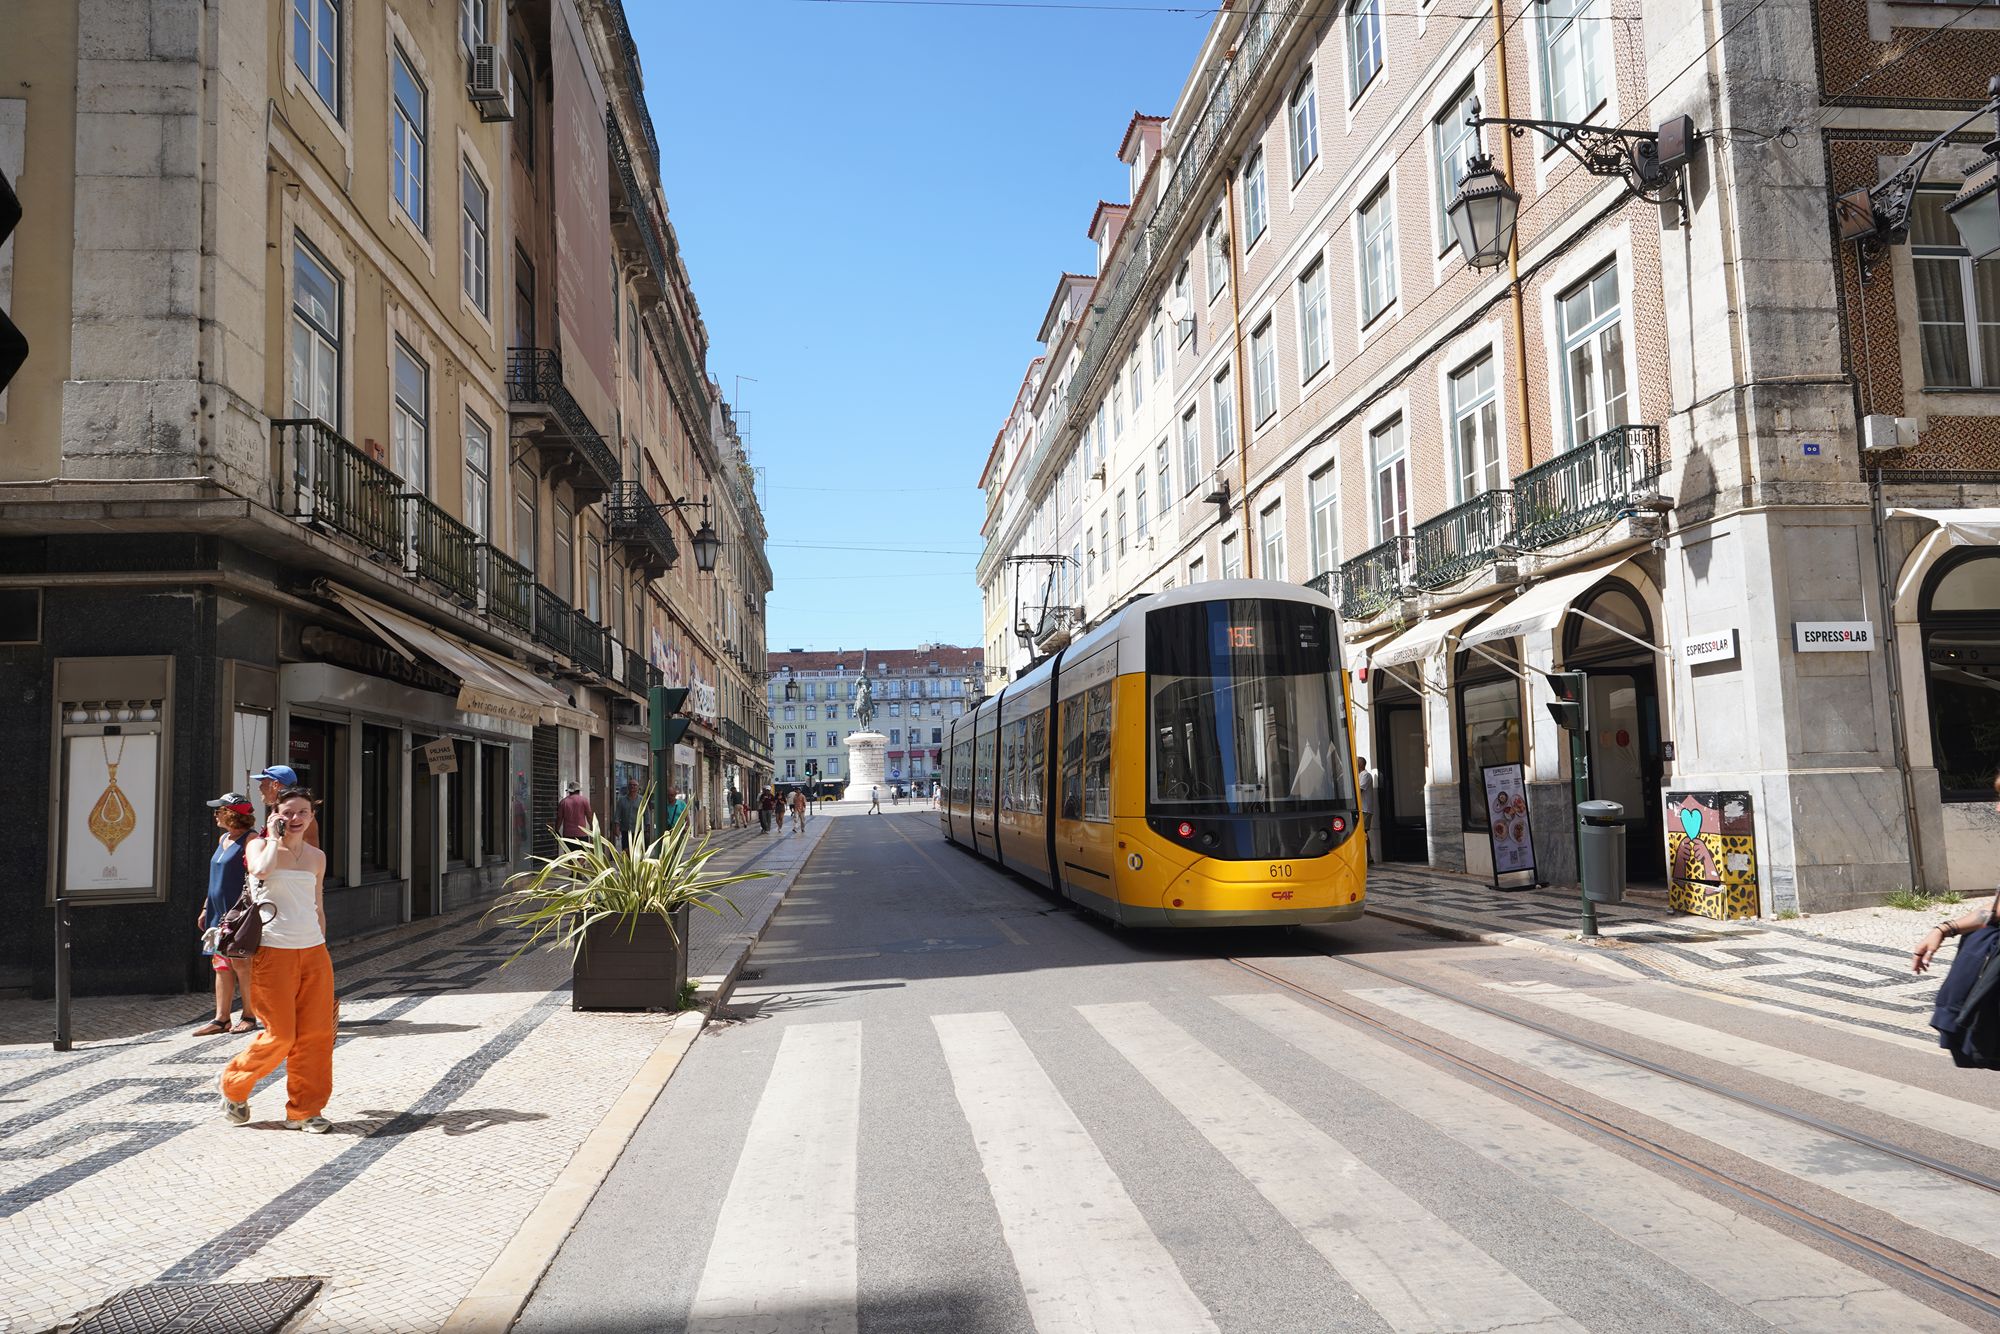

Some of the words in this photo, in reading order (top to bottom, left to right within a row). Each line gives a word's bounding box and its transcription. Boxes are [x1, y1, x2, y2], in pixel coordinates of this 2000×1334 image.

[1228, 627, 1255, 648] 15E
[1805, 630, 1868, 643] ESPRESSOLAB
[1686, 638, 1729, 657] ESPRESSOLAB
[1270, 864, 1292, 878] 610
[1271, 891, 1294, 901] CAF
